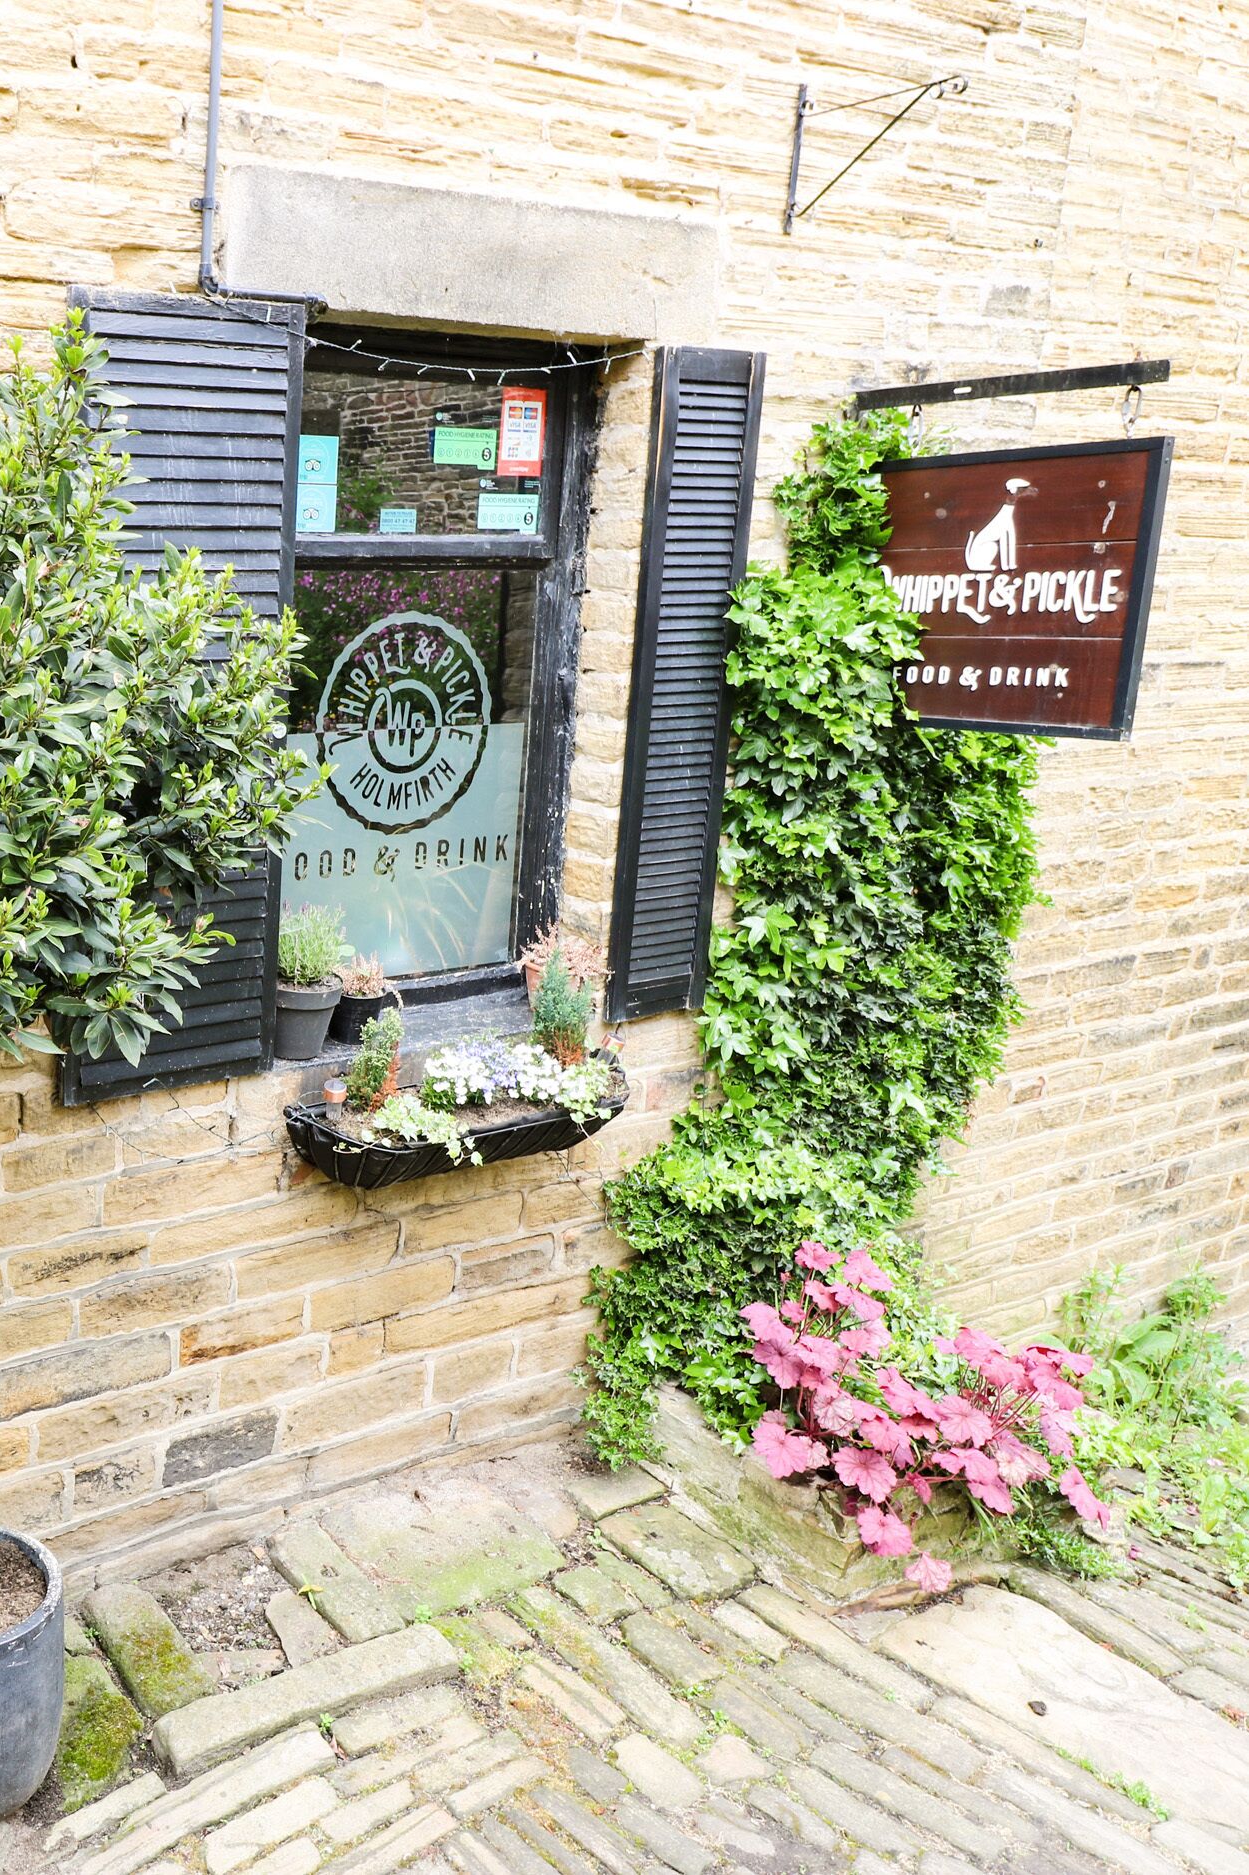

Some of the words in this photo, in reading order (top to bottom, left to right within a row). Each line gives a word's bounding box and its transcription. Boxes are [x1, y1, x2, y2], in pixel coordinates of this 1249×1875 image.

[438, 430, 453, 438] FOOD
[483, 448, 490, 460] 5
[482, 496, 497, 504] FOOD
[525, 512, 532, 524] 5
[879, 565, 992, 624] WHIPPET
[989, 574, 1022, 616] &
[1021, 569, 1122, 624] PICKLE
[892, 665, 951, 685] FOOD
[958, 666, 983, 692] &
[989, 666, 1070, 688] DRINK
[328, 632, 411, 756] WHIPPET
[414, 636, 438, 674] &
[433, 645, 477, 745] PICKLE
[350, 757, 457, 811] HOLMFIRTH
[281, 847, 357, 881] OOD
[372, 845, 400, 882] &
[414, 833, 509, 870] DRINK
